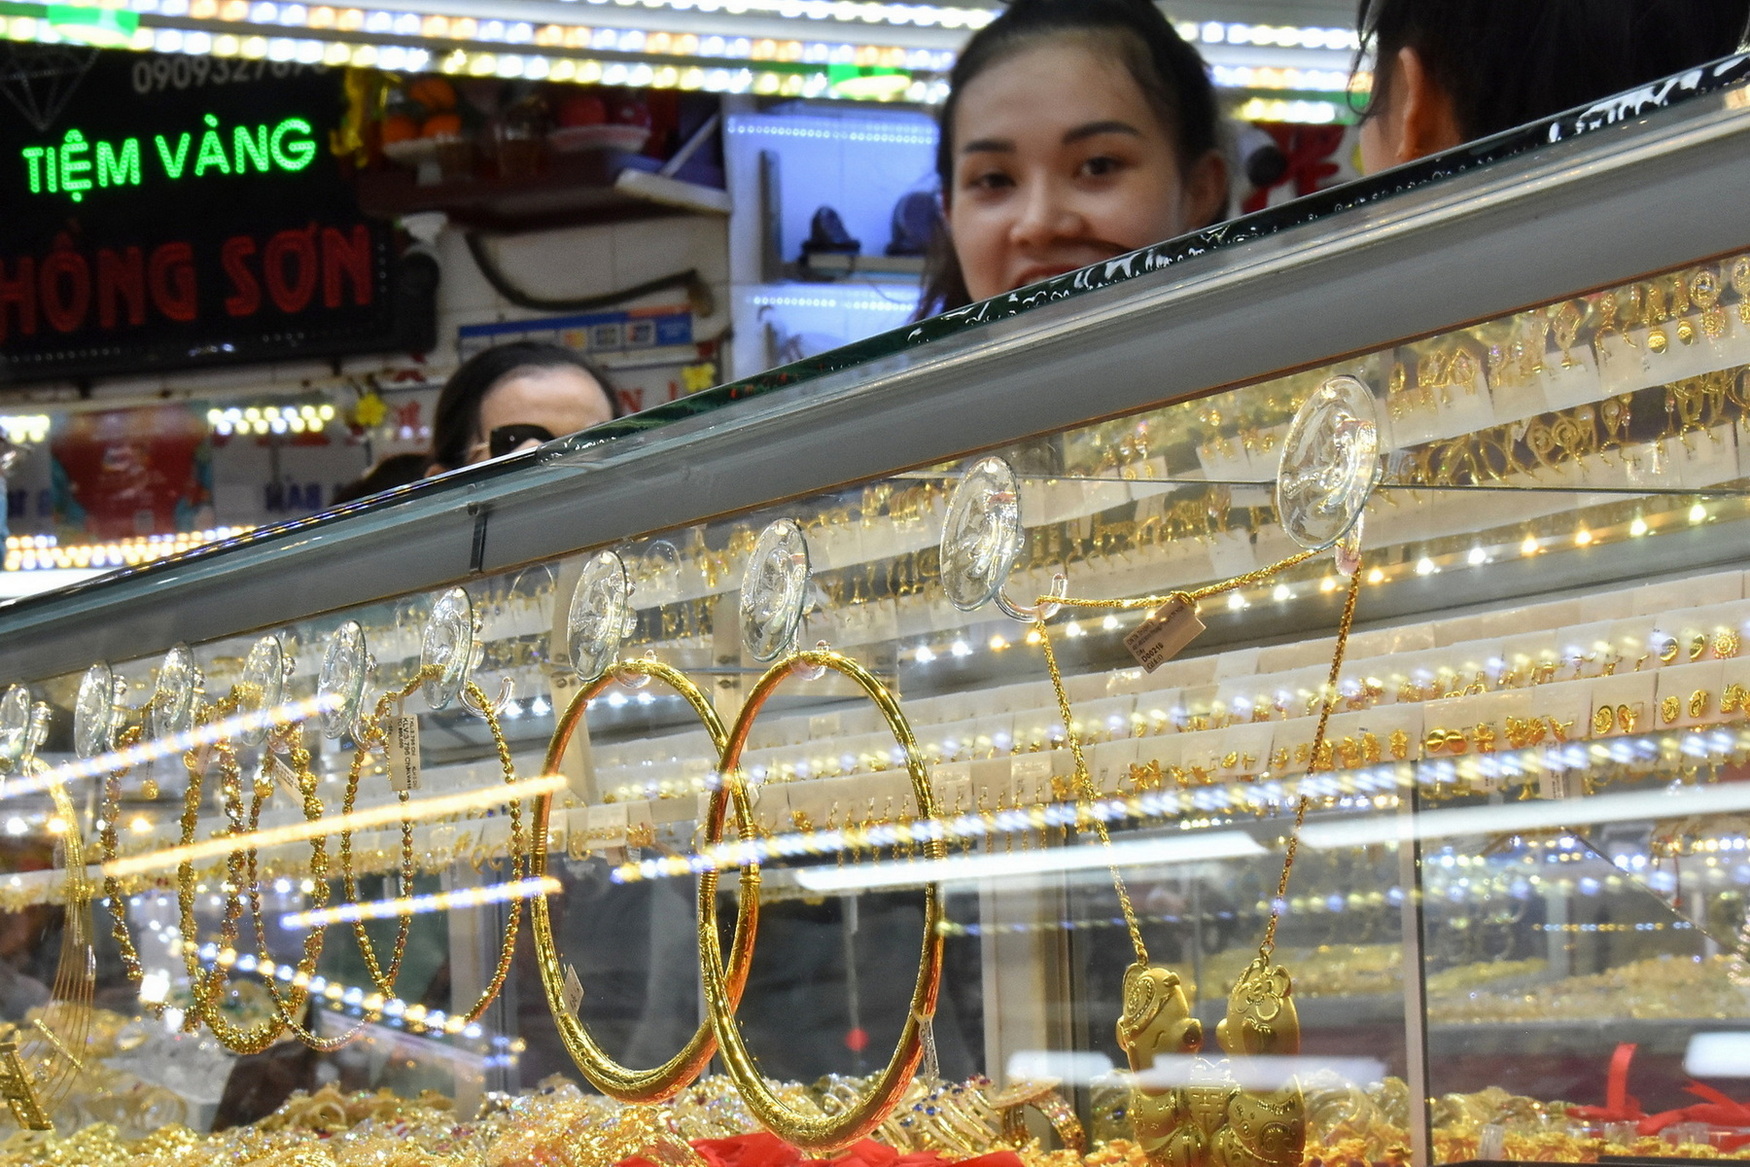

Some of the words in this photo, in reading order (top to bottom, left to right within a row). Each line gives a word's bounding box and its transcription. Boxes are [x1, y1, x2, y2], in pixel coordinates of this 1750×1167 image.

[22, 128, 142, 202] TIỆM
[155, 113, 316, 178] VÀNG
[220, 221, 373, 318] SƠN
